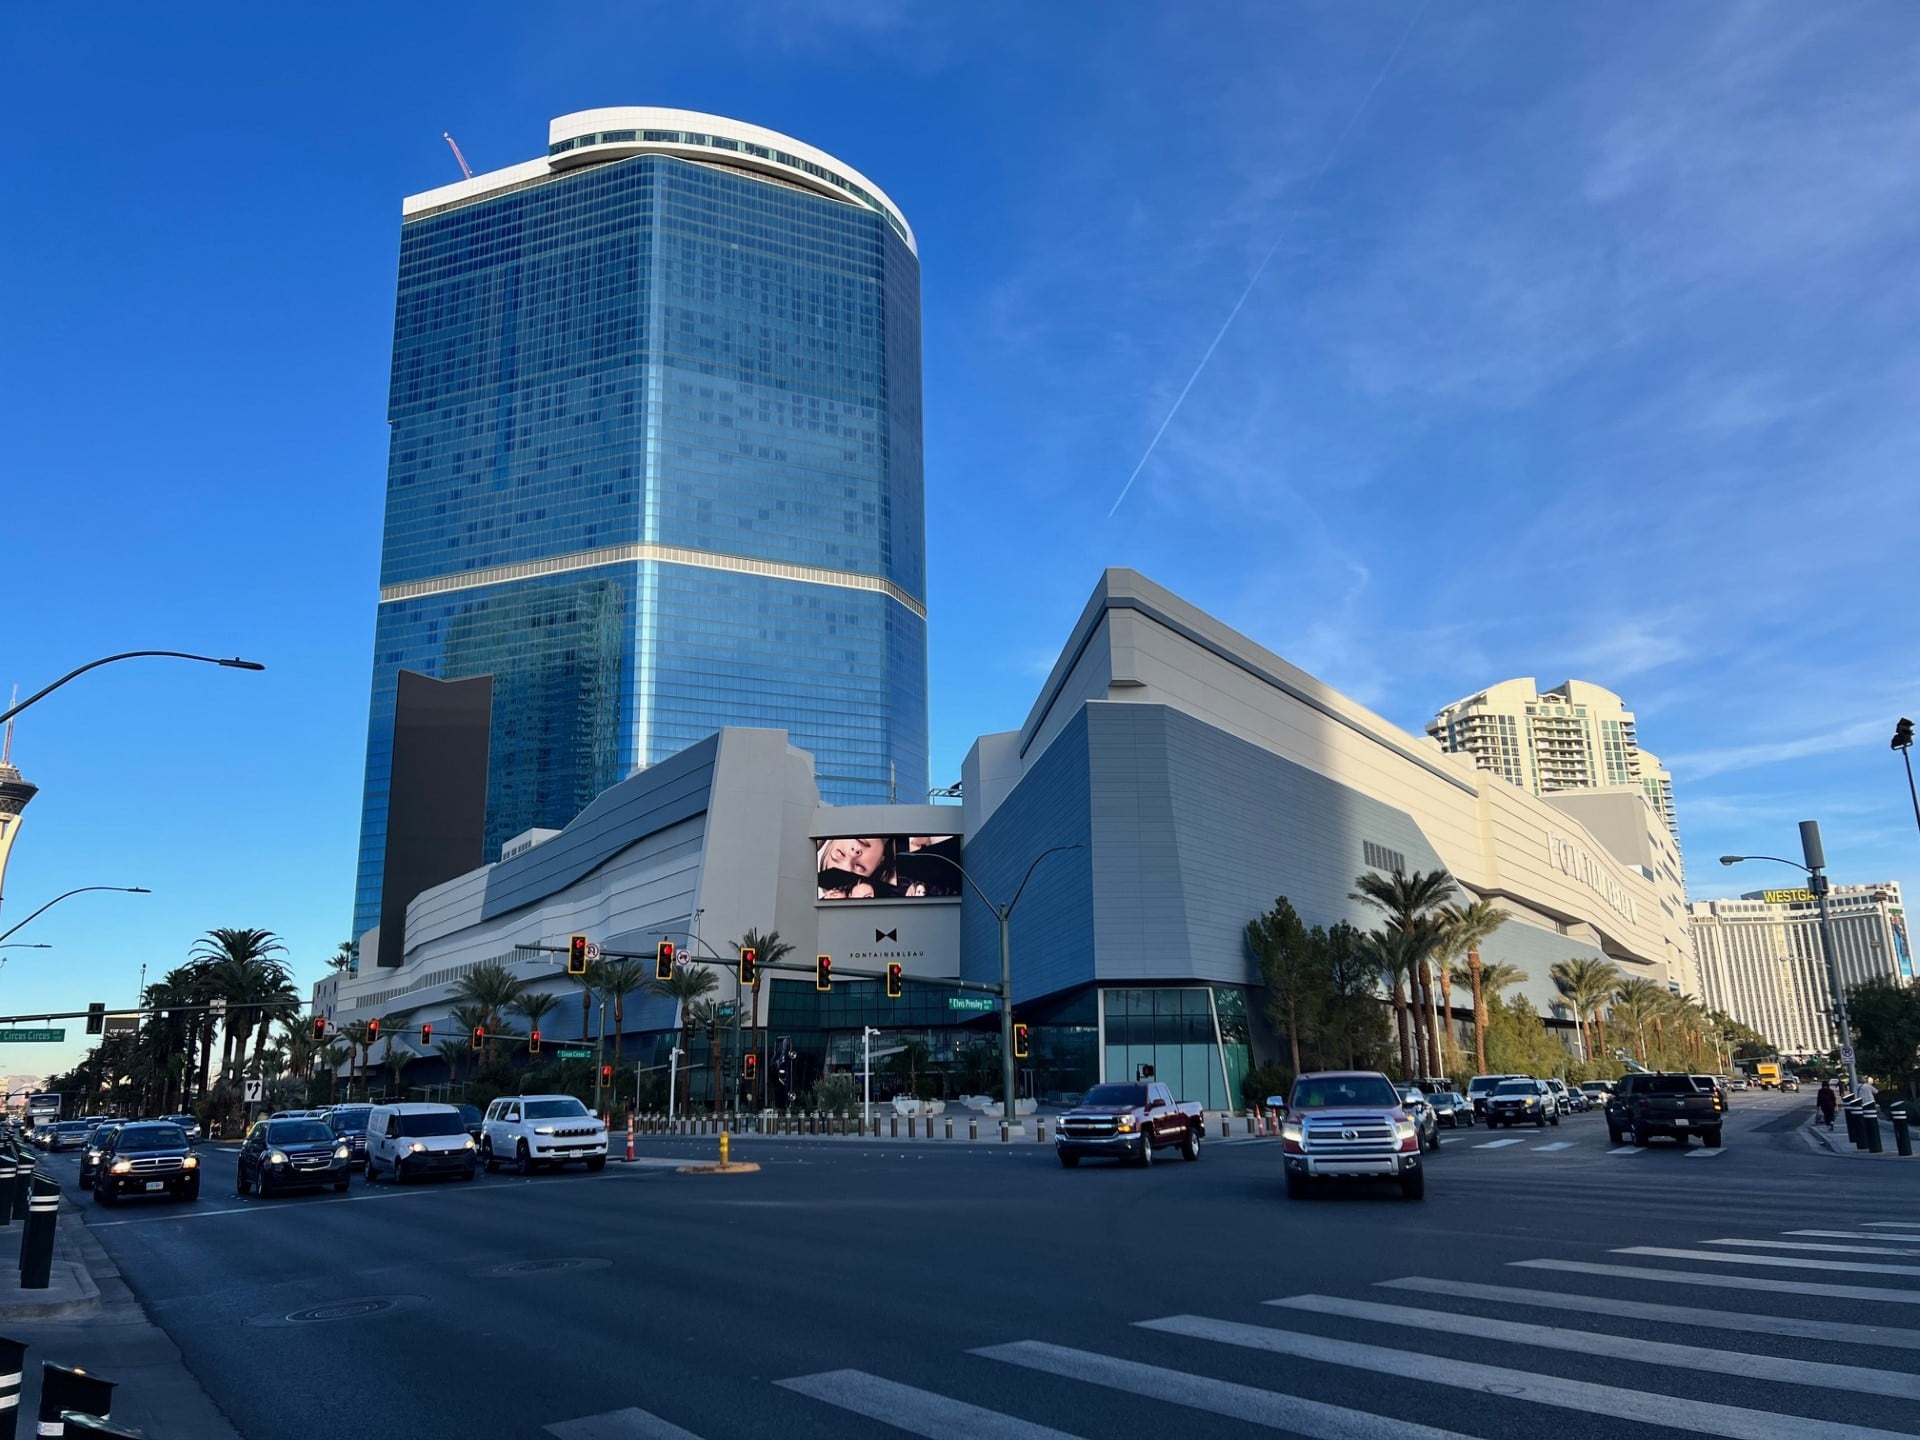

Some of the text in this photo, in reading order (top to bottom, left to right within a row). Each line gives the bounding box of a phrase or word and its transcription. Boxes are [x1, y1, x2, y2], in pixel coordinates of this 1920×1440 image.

[1763, 889, 1819, 903] WESTGA
[3, 1031, 26, 1041] Circus
[27, 1031, 50, 1041] Circus
